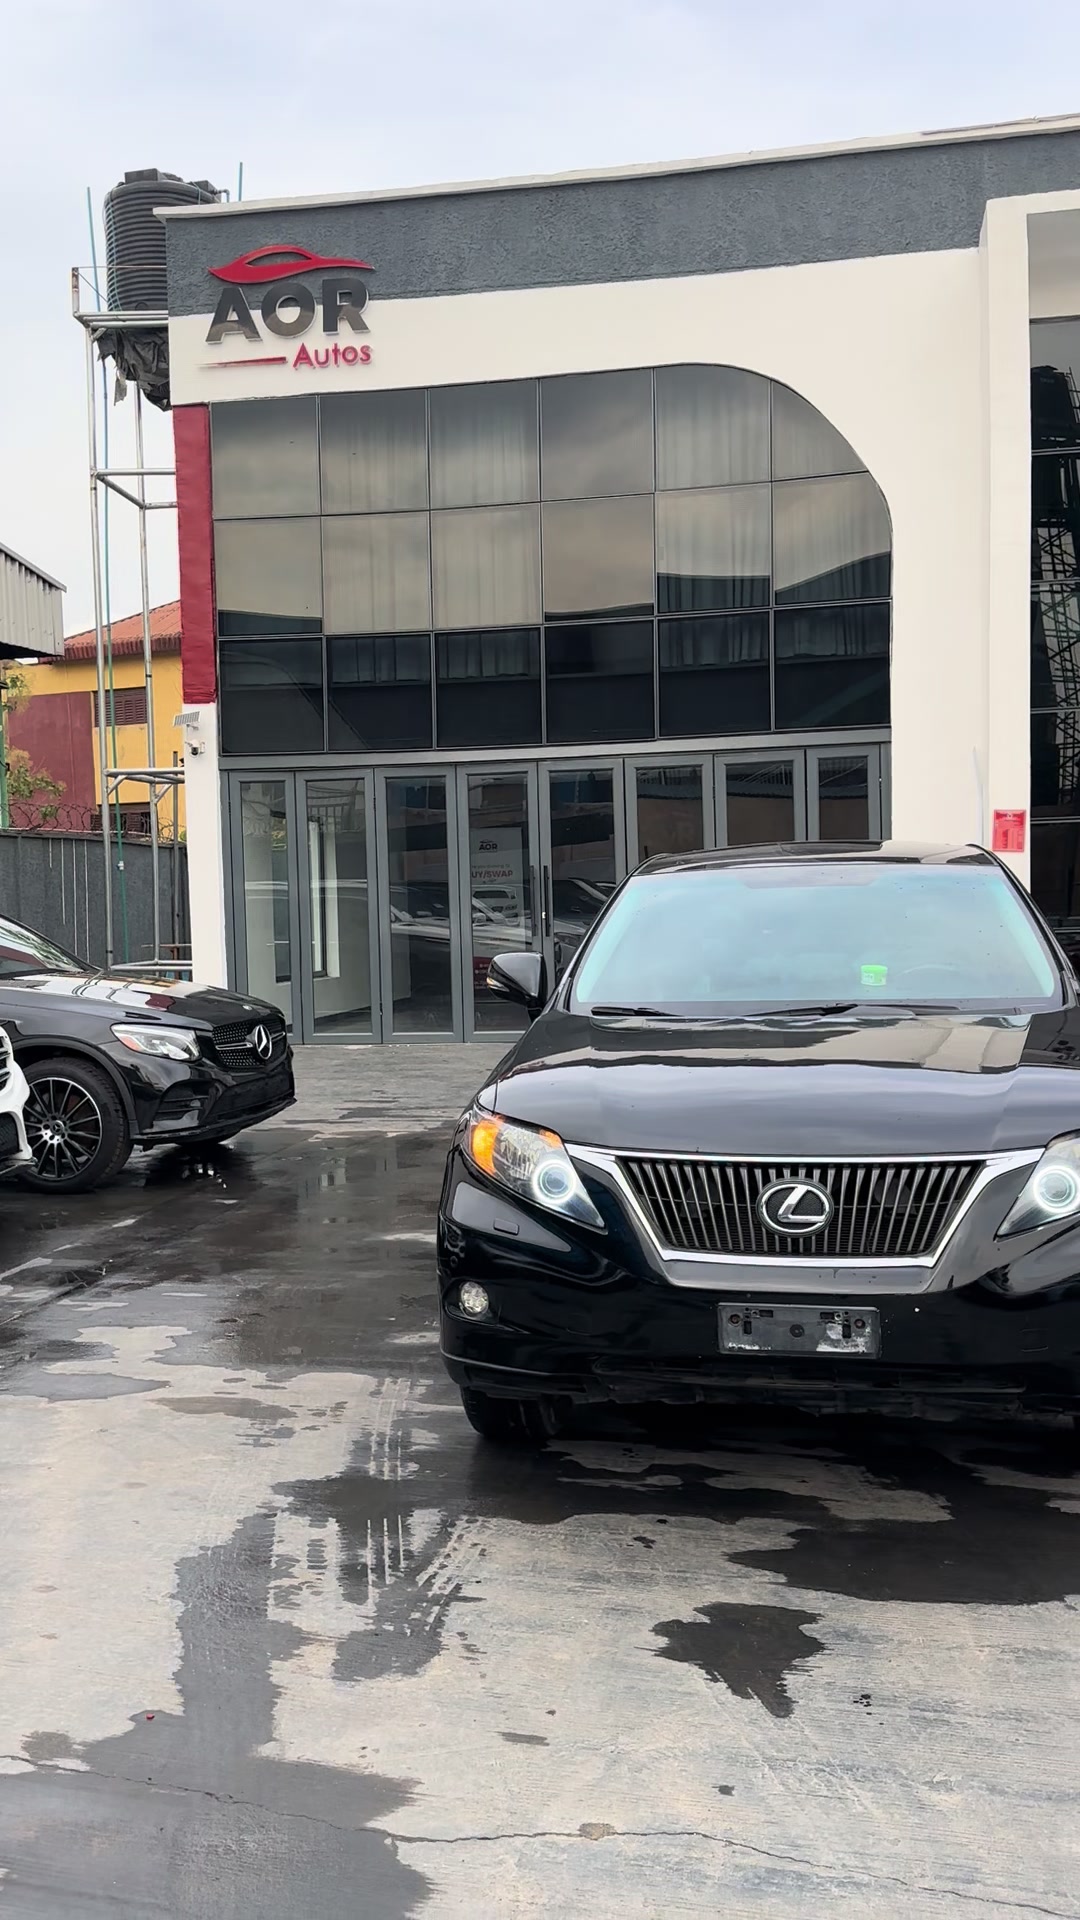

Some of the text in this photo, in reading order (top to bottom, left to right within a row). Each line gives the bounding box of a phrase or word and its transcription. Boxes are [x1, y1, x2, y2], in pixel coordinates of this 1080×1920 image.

[205, 278, 370, 344] AOR
[293, 343, 372, 370] Autos
[471, 870, 513, 879] UY/SWAP
